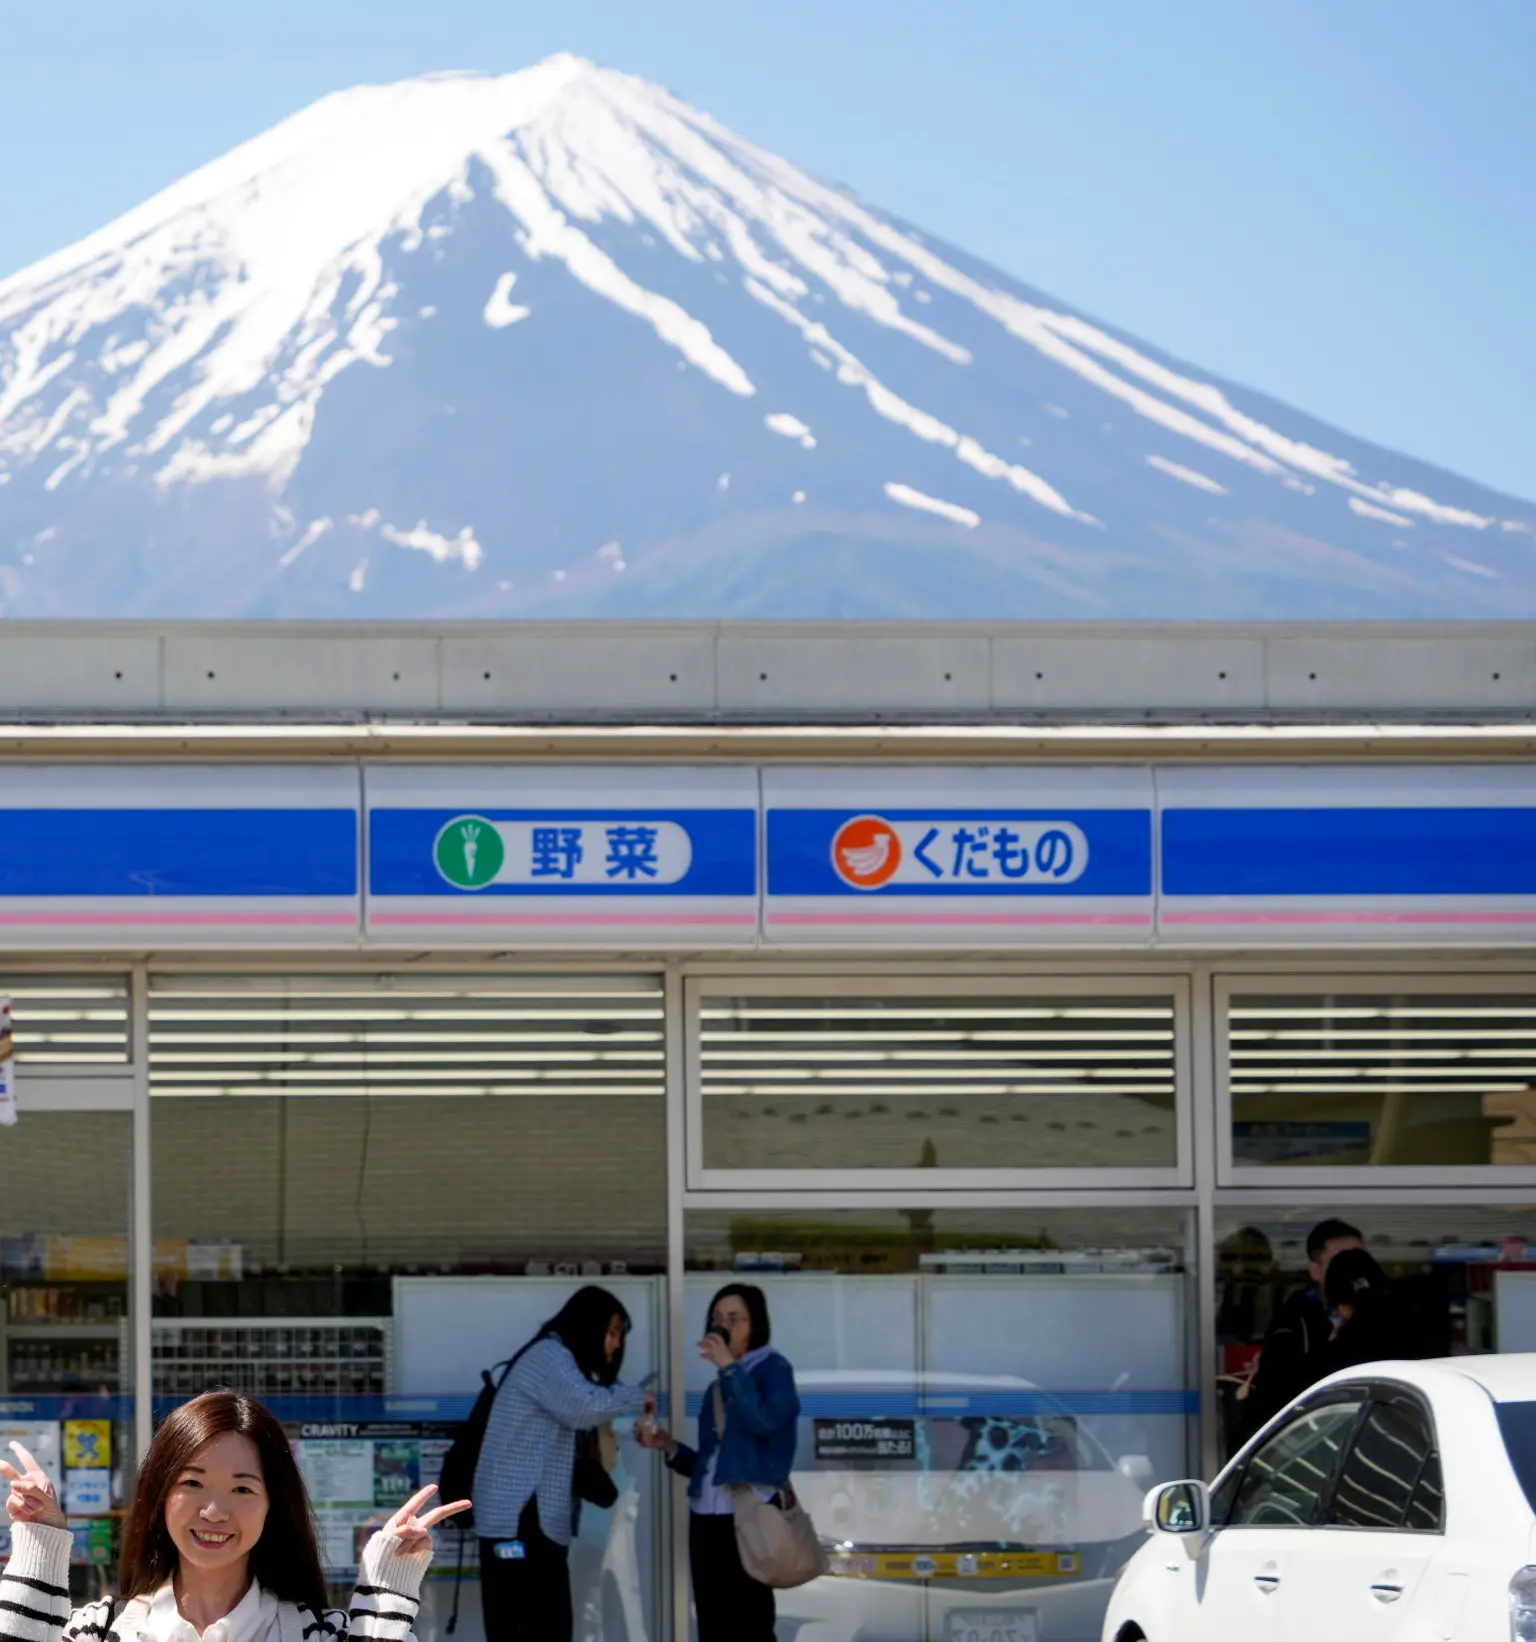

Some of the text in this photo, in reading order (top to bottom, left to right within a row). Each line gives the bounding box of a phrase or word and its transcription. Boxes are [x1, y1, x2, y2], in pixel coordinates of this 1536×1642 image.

[530, 827, 659, 879] 野菜
[913, 827, 1073, 877] くだもの
[301, 1423, 359, 1437] CRAVITY
